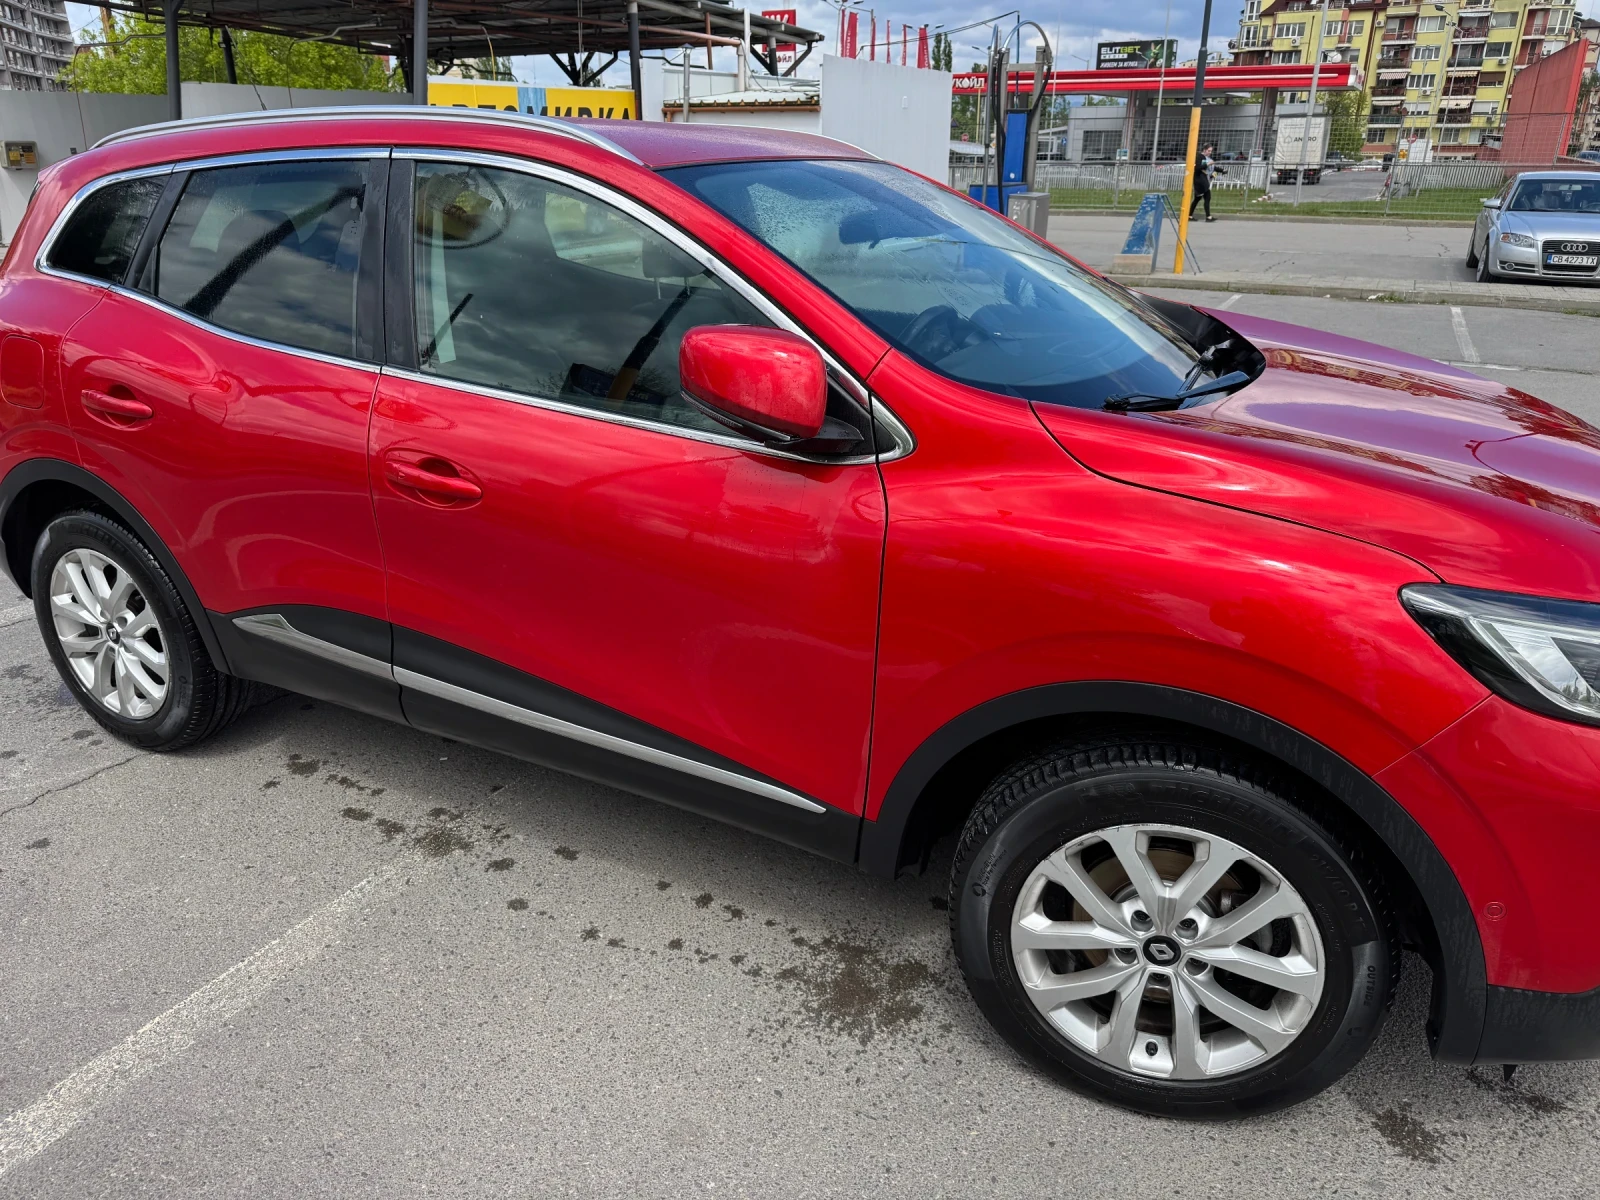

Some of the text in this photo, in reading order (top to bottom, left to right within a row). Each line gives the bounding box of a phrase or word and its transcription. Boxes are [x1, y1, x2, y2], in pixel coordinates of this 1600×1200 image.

[1101, 46, 1141, 54] ELITBET
[952, 76, 985, 88] УКОЙЛ
[1552, 255, 1596, 265] CB 4273 TX
[976, 852, 996, 882] MICHELIN
[1363, 965, 1376, 1006] OUTSIDE
